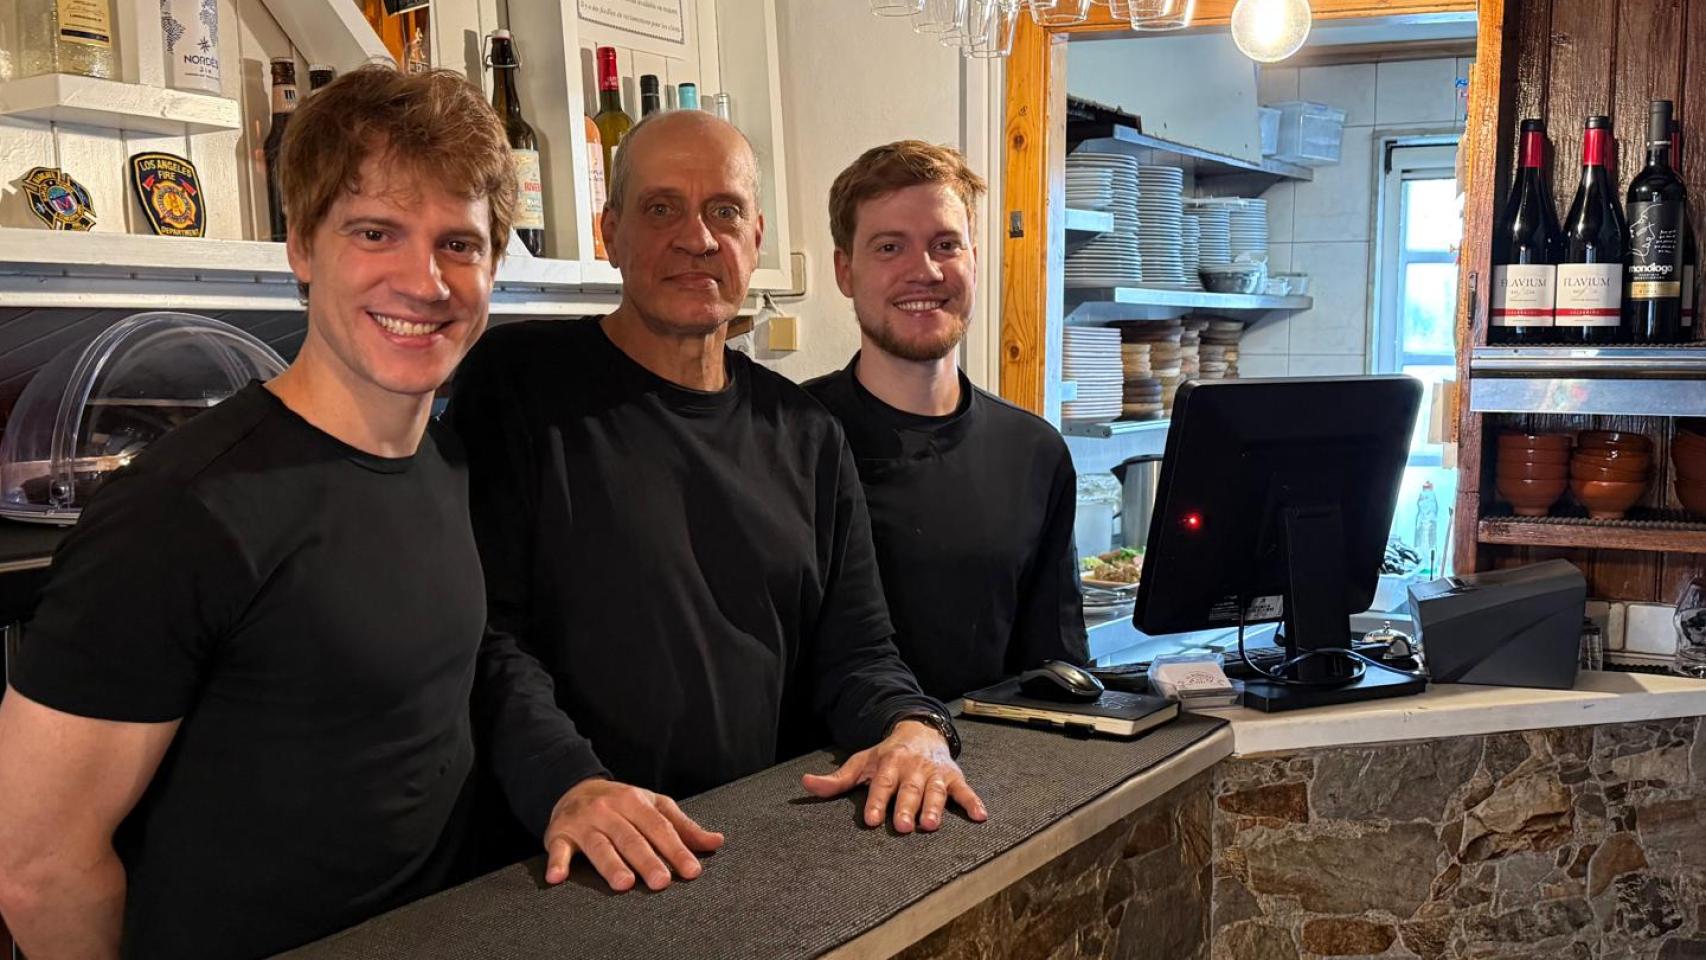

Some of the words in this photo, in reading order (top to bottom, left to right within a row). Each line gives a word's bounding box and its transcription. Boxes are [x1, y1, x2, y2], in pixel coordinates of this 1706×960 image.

[139, 159, 156, 171] LOS
[157, 159, 192, 178] ANGELES
[157, 170, 177, 181] FIRE
